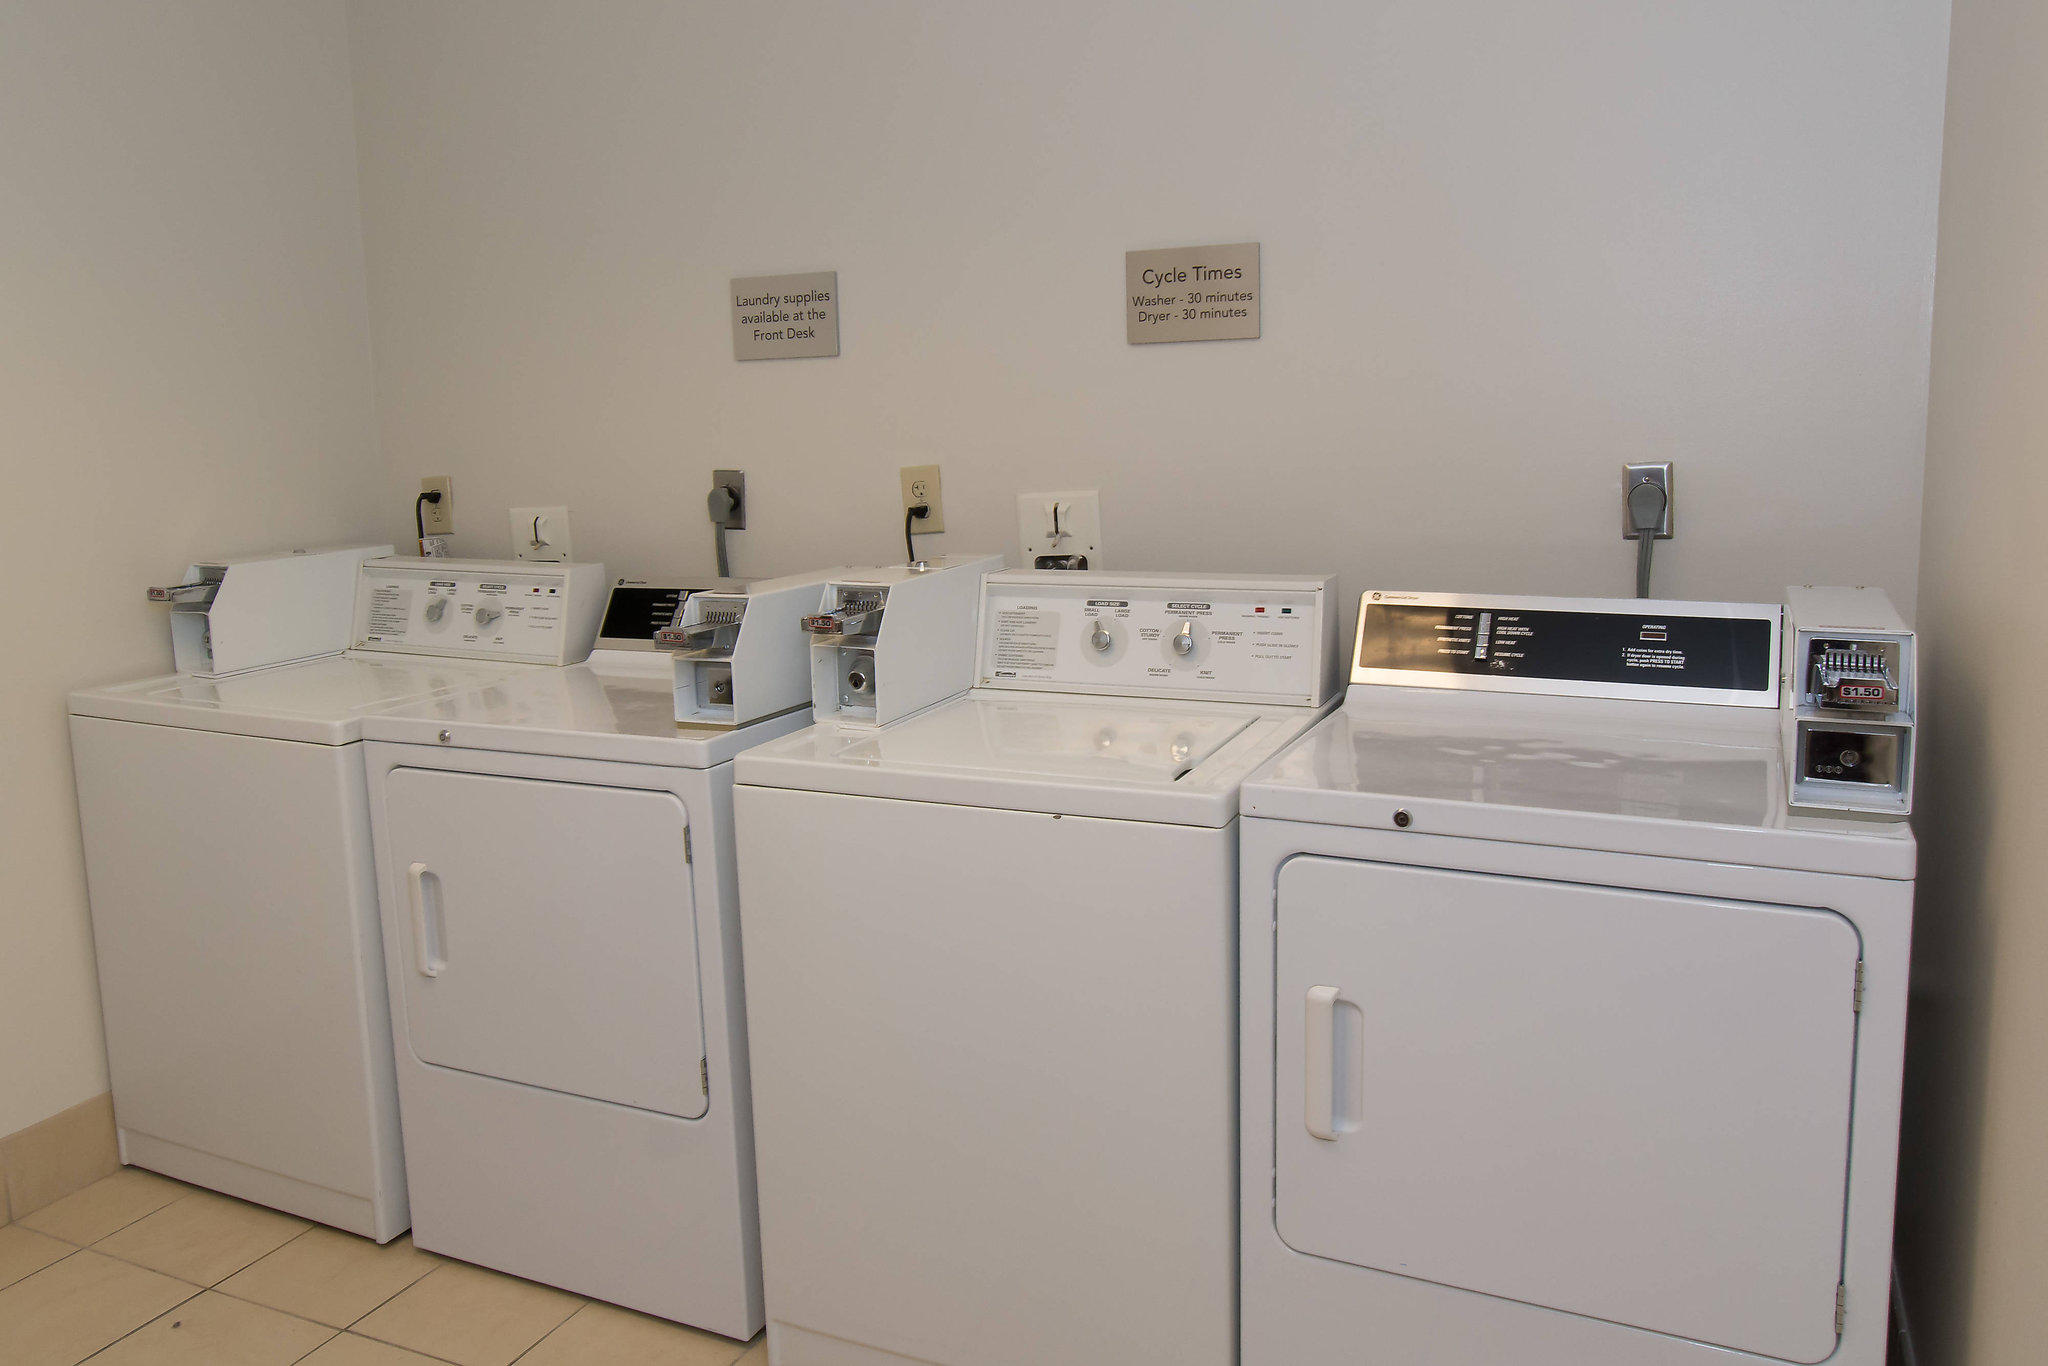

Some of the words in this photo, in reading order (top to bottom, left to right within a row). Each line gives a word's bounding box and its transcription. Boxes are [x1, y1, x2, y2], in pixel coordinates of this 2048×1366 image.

[1142, 267, 1187, 288] Cycle
[1192, 265, 1242, 281] Times
[736, 293, 780, 308] Laundry
[783, 290, 830, 307] supplies
[1132, 294, 1176, 307] Washer
[1187, 292, 1201, 304] 30
[1205, 291, 1253, 303] minutes
[741, 309, 789, 324] available
[793, 311, 804, 321] at
[807, 308, 826, 320] the
[1138, 310, 1171, 325] Dryer
[1182, 308, 1196, 320] 30
[1200, 307, 1247, 319] minutes
[753, 329, 783, 341] Front
[787, 326, 815, 339] Desk
[1842, 687, 1880, 697] $1.50
